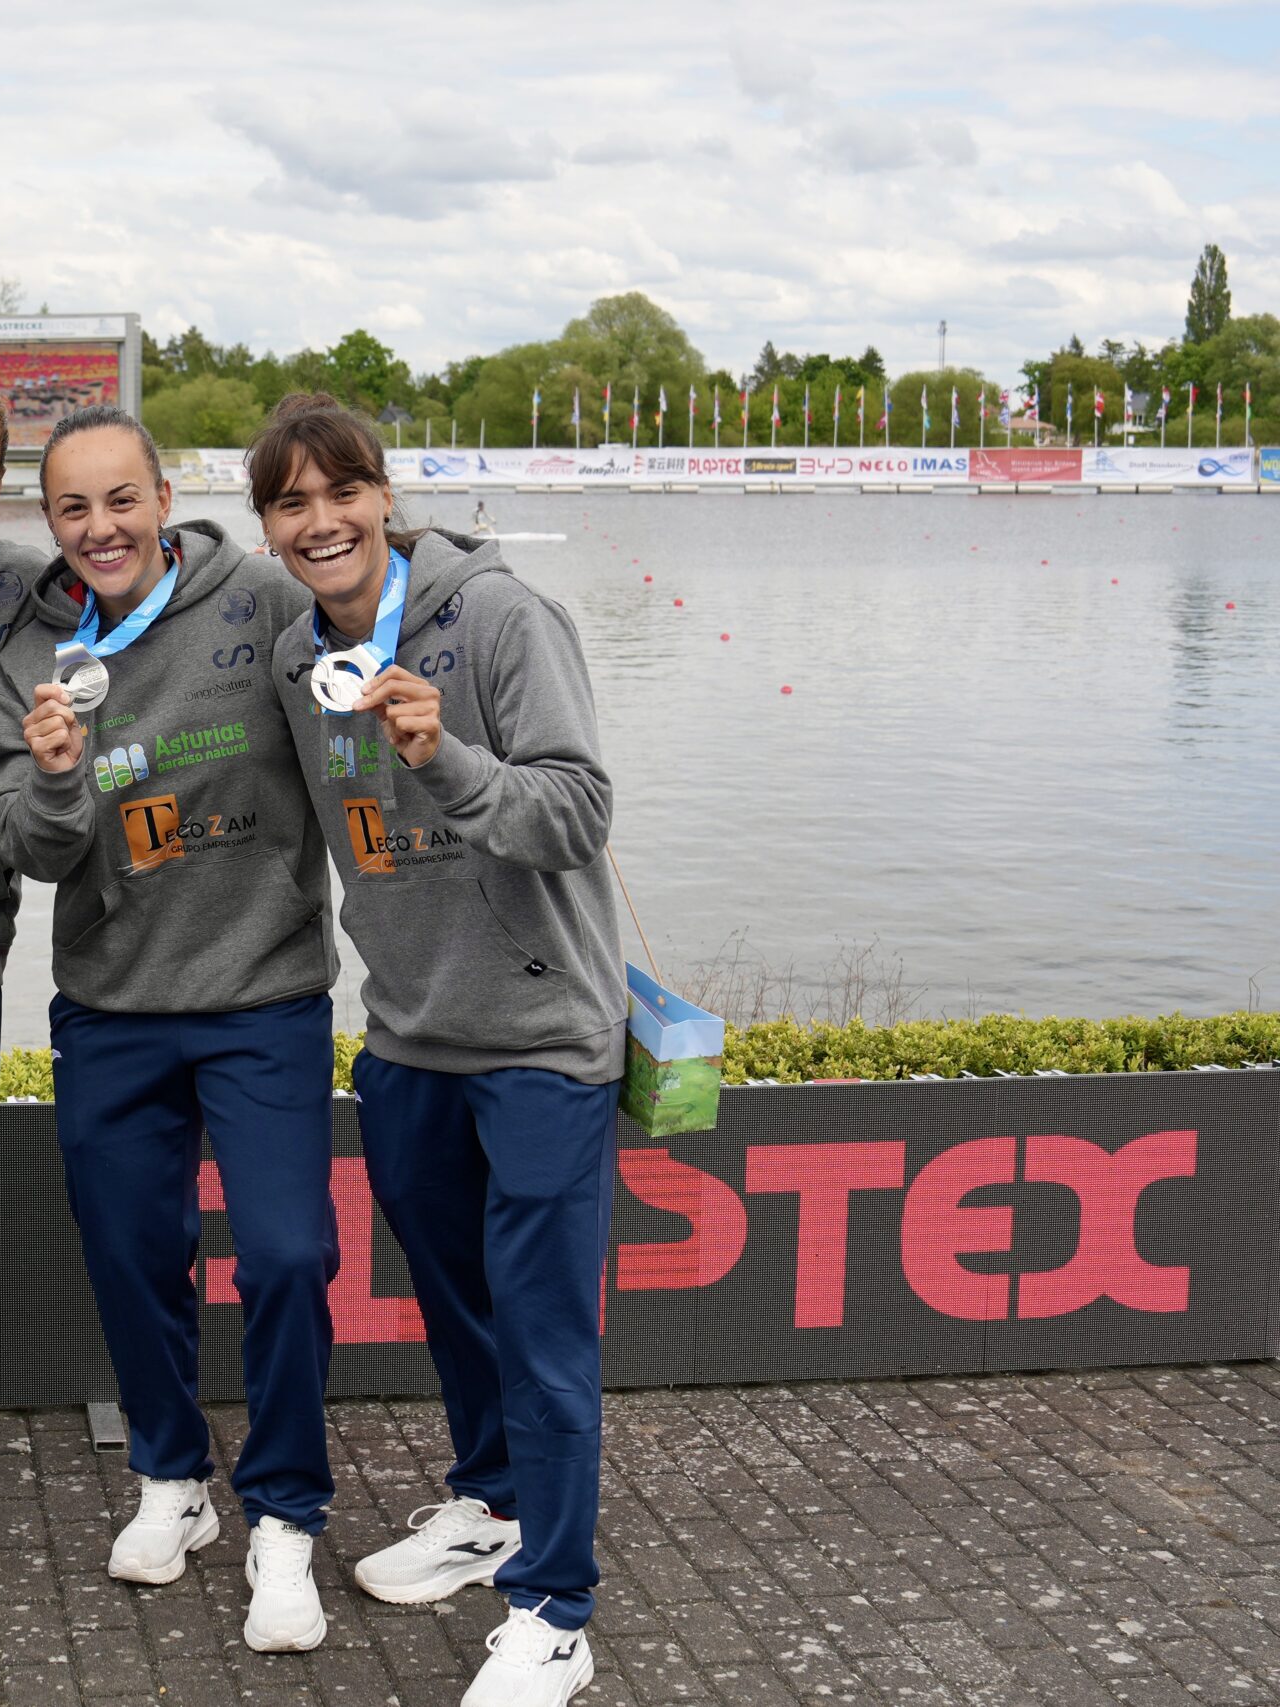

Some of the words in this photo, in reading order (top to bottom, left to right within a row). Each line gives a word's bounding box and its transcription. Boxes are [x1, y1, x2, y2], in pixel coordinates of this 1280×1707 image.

[913, 458, 967, 471] IMAS
[184, 678, 253, 702] DingoNatura
[155, 721, 246, 759] Asturias
[205, 740, 250, 761] natural
[171, 842, 201, 854] GRUPO
[202, 833, 256, 851] EMPRESARIAL
[384, 855, 411, 868] GRUPO
[411, 850, 466, 865] EMPRESARIAL
